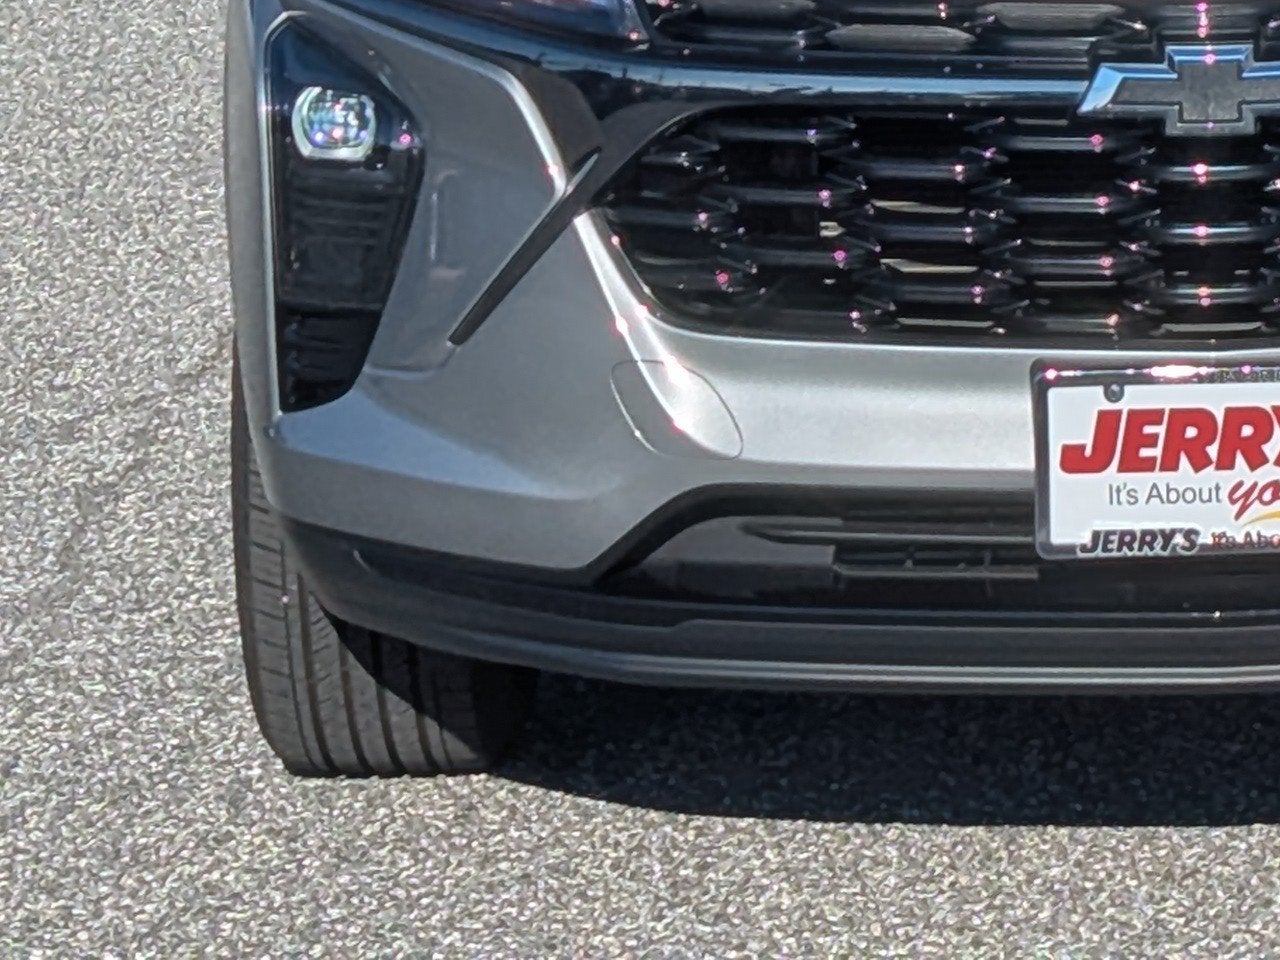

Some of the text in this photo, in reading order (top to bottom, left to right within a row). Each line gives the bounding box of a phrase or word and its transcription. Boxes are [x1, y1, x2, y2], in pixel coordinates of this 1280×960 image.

[1107, 482, 1139, 506] It's
[1145, 481, 1222, 505] About
[1078, 526, 1202, 555] JERRY'S
